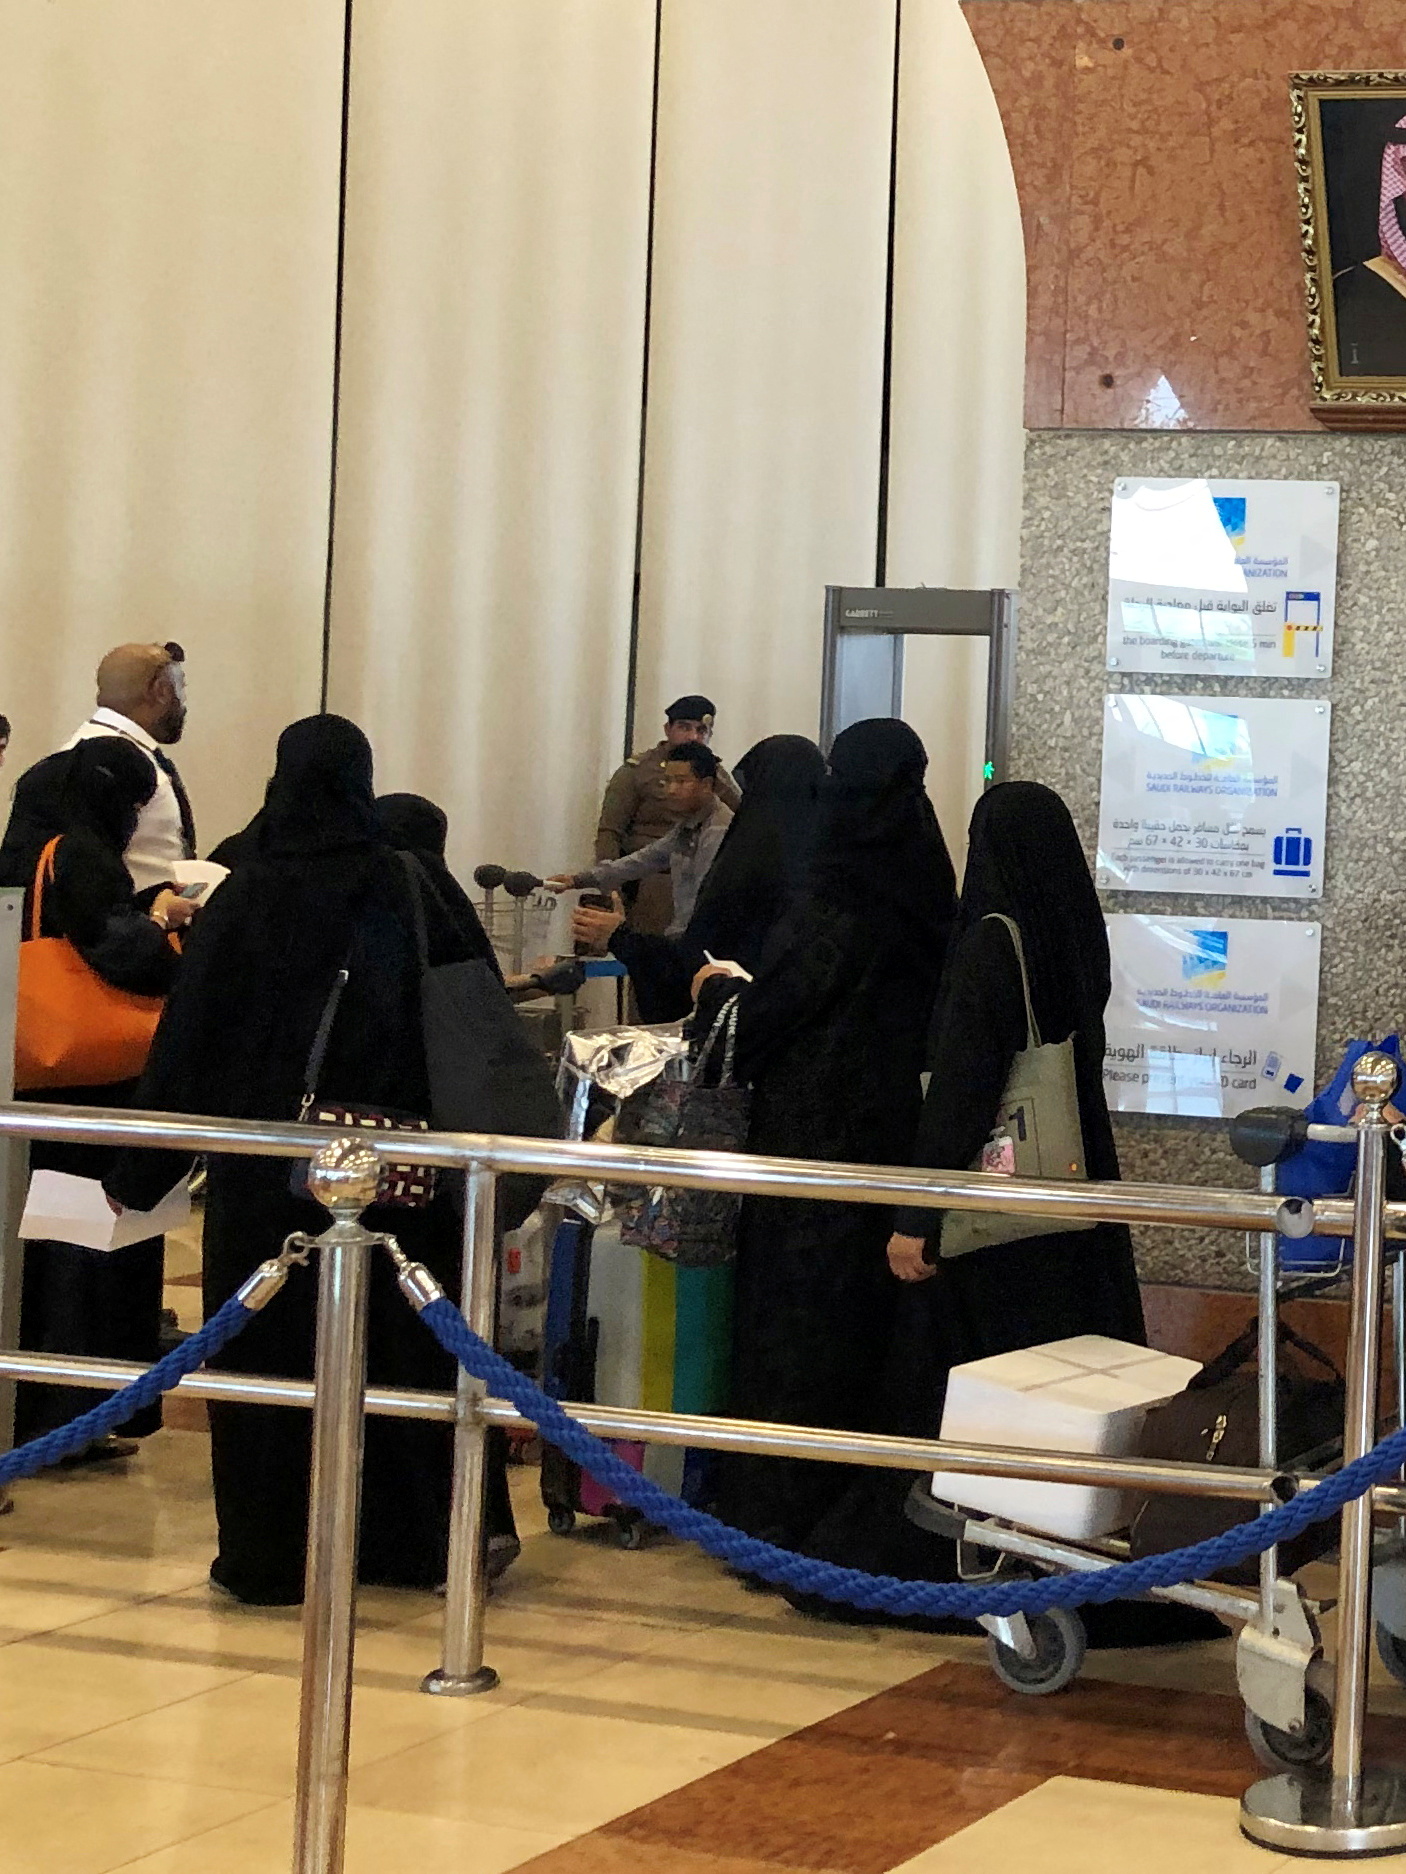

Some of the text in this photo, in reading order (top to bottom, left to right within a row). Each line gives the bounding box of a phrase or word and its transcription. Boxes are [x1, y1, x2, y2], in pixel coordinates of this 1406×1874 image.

[1123, 636, 1137, 646] the
[1259, 640, 1277, 648] min
[1161, 650, 1189, 660] before
[1146, 782, 1171, 792] SAUDI
[1173, 783, 1213, 794] RAILWAYS
[1113, 819, 1139, 832] واحدة
[1192, 821, 1220, 835] مسافر
[1242, 826, 1267, 837] يسمح
[1145, 834, 1159, 846] 67
[1169, 836, 1184, 847] 42
[1195, 837, 1209, 849] 30
[1176, 856, 1205, 864] allowed
[1215, 859, 1234, 868] carry
[1251, 859, 1266, 870] bag
[1141, 865, 1182, 874] dimensions
[1183, 866, 1191, 874] of
[1211, 868, 1222, 876] 42
[1163, 1000, 1204, 1011] RAILWAYS
[1205, 1002, 1268, 1014] ORGANIZATION
[1220, 1048, 1257, 1069] الرجاء
[1232, 1077, 1257, 1090] card
